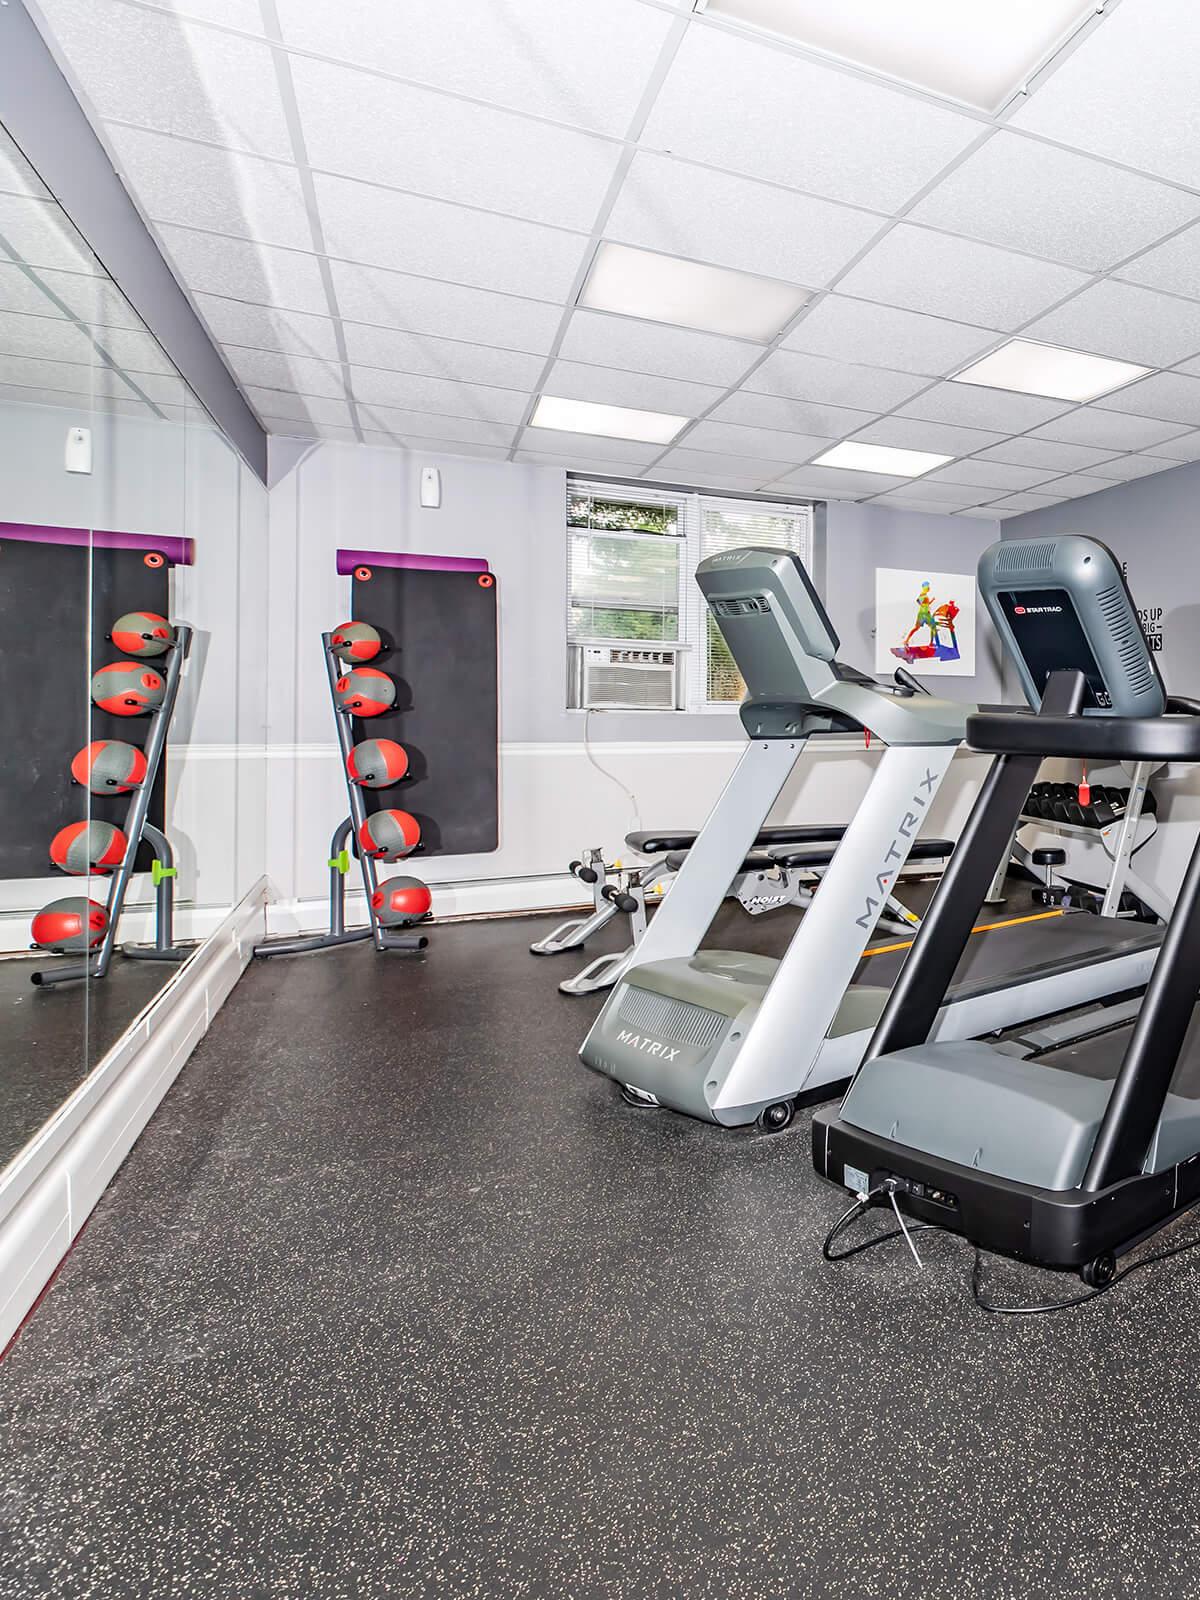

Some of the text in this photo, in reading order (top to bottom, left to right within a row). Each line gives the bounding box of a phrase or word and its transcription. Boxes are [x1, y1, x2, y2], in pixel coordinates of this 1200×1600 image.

[1150, 608, 1162, 621] UP
[856, 768, 939, 929] MATRIX
[616, 1030, 680, 1062] MATRIX
